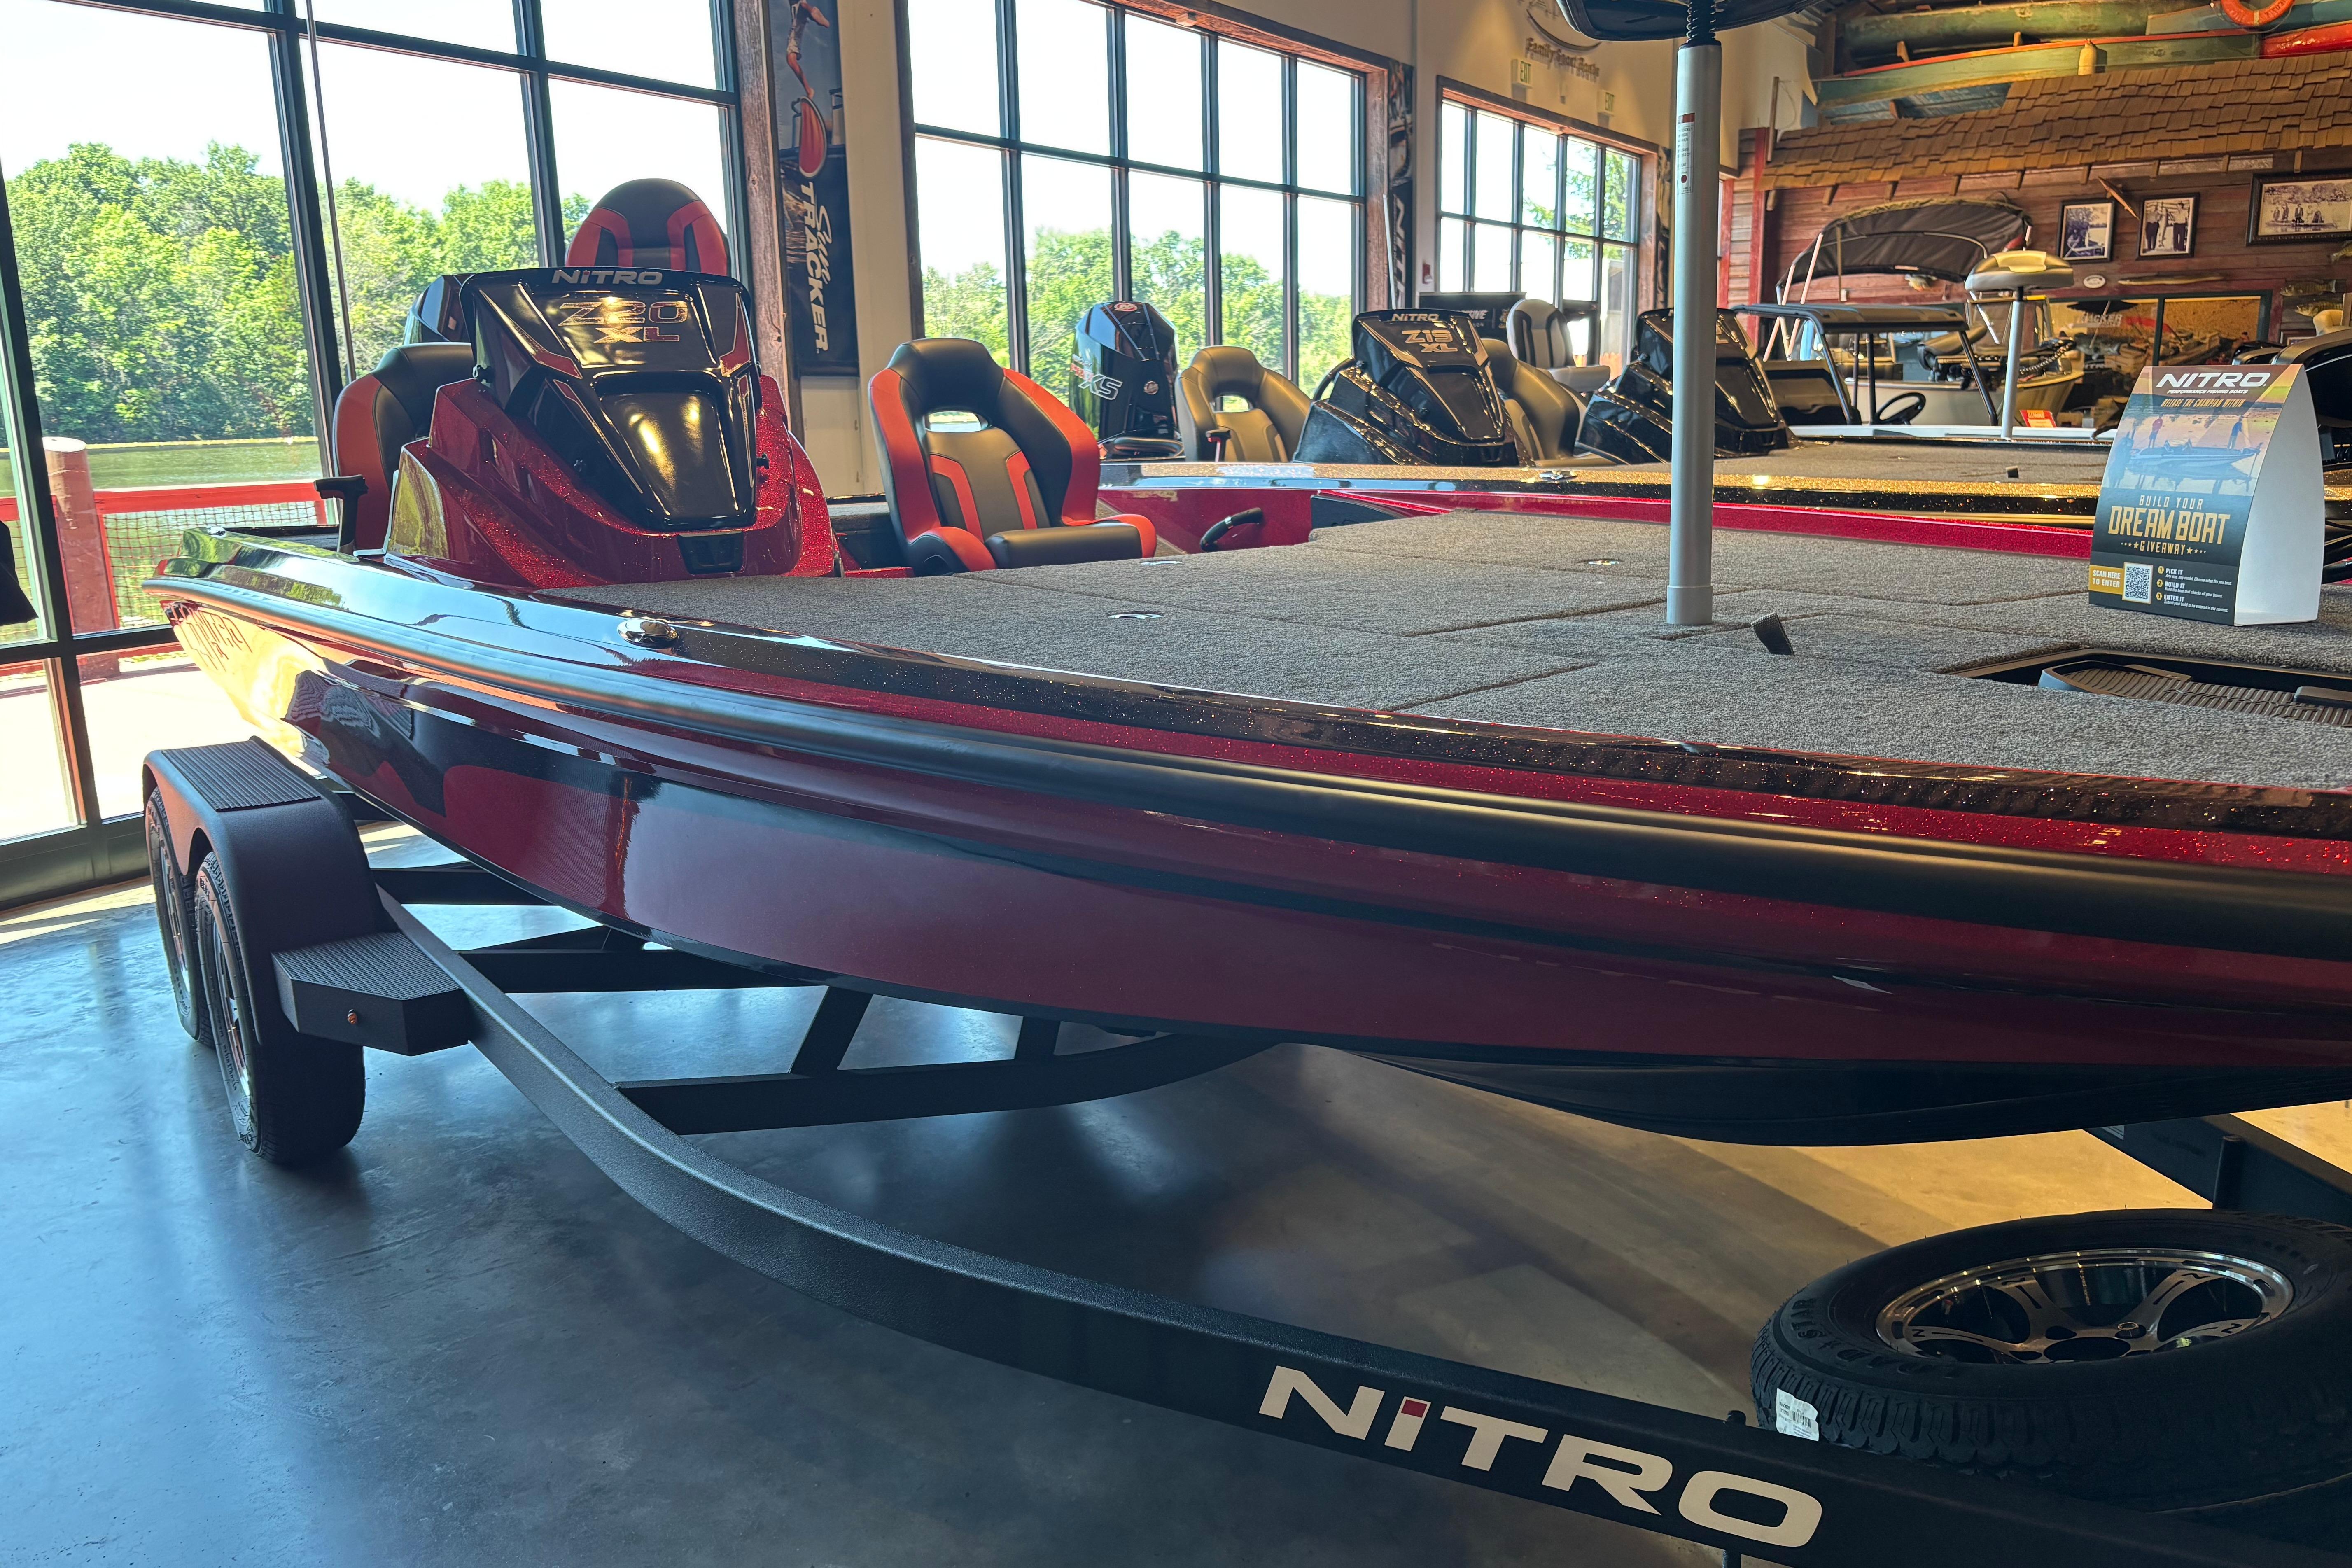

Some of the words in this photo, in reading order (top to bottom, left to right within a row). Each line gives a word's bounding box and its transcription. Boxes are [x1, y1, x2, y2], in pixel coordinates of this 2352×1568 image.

[801, 182, 829, 351] TRACKER
[551, 270, 663, 285] NITRO
[558, 301, 688, 327] Z20
[593, 327, 680, 344] XL
[1402, 330, 1453, 343] Z19
[1419, 343, 1458, 352] XL
[1078, 373, 1123, 401] XS
[2156, 372, 2270, 387] NITRO
[2139, 495, 2170, 507] BUILD
[2176, 497, 2203, 510] YOUR
[2108, 506, 2175, 539] DREAM
[2175, 511, 2231, 544] BOAT
[2140, 540, 2185, 555] GIVEAWAY
[2102, 579, 2120, 588] ENTER
[1259, 1365, 1822, 1547] NITRO
